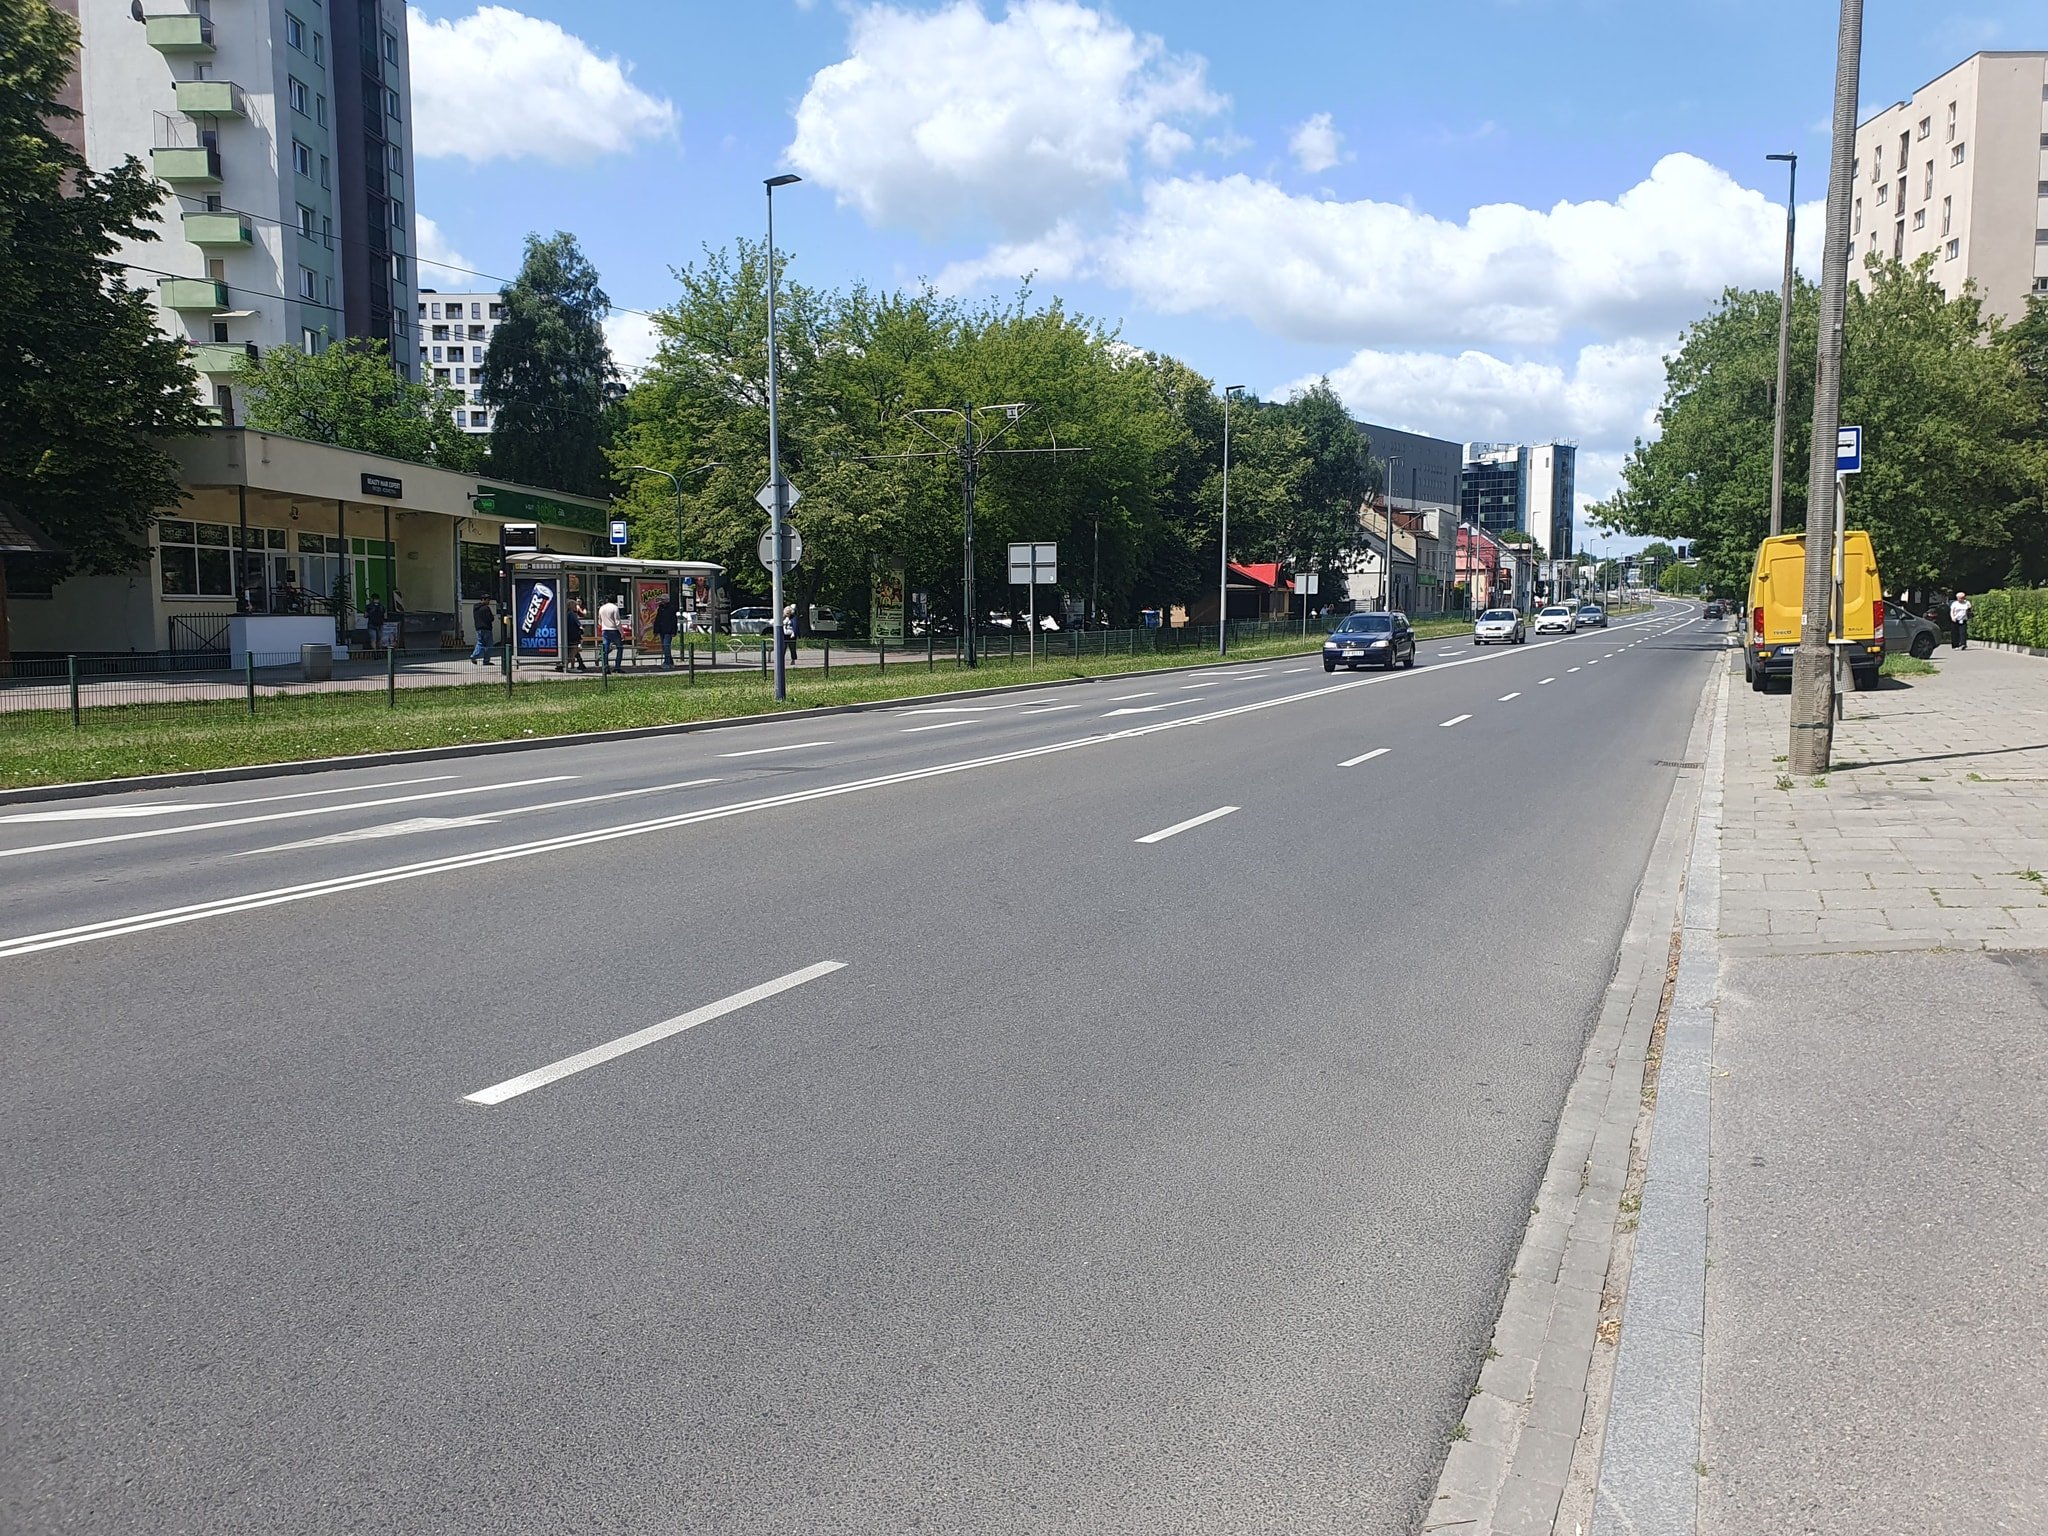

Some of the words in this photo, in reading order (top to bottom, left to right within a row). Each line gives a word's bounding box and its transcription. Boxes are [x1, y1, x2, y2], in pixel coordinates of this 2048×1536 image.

[522, 594, 544, 634] TIGER
[535, 624, 557, 638] RÓB
[521, 637, 557, 648] SWOJE
